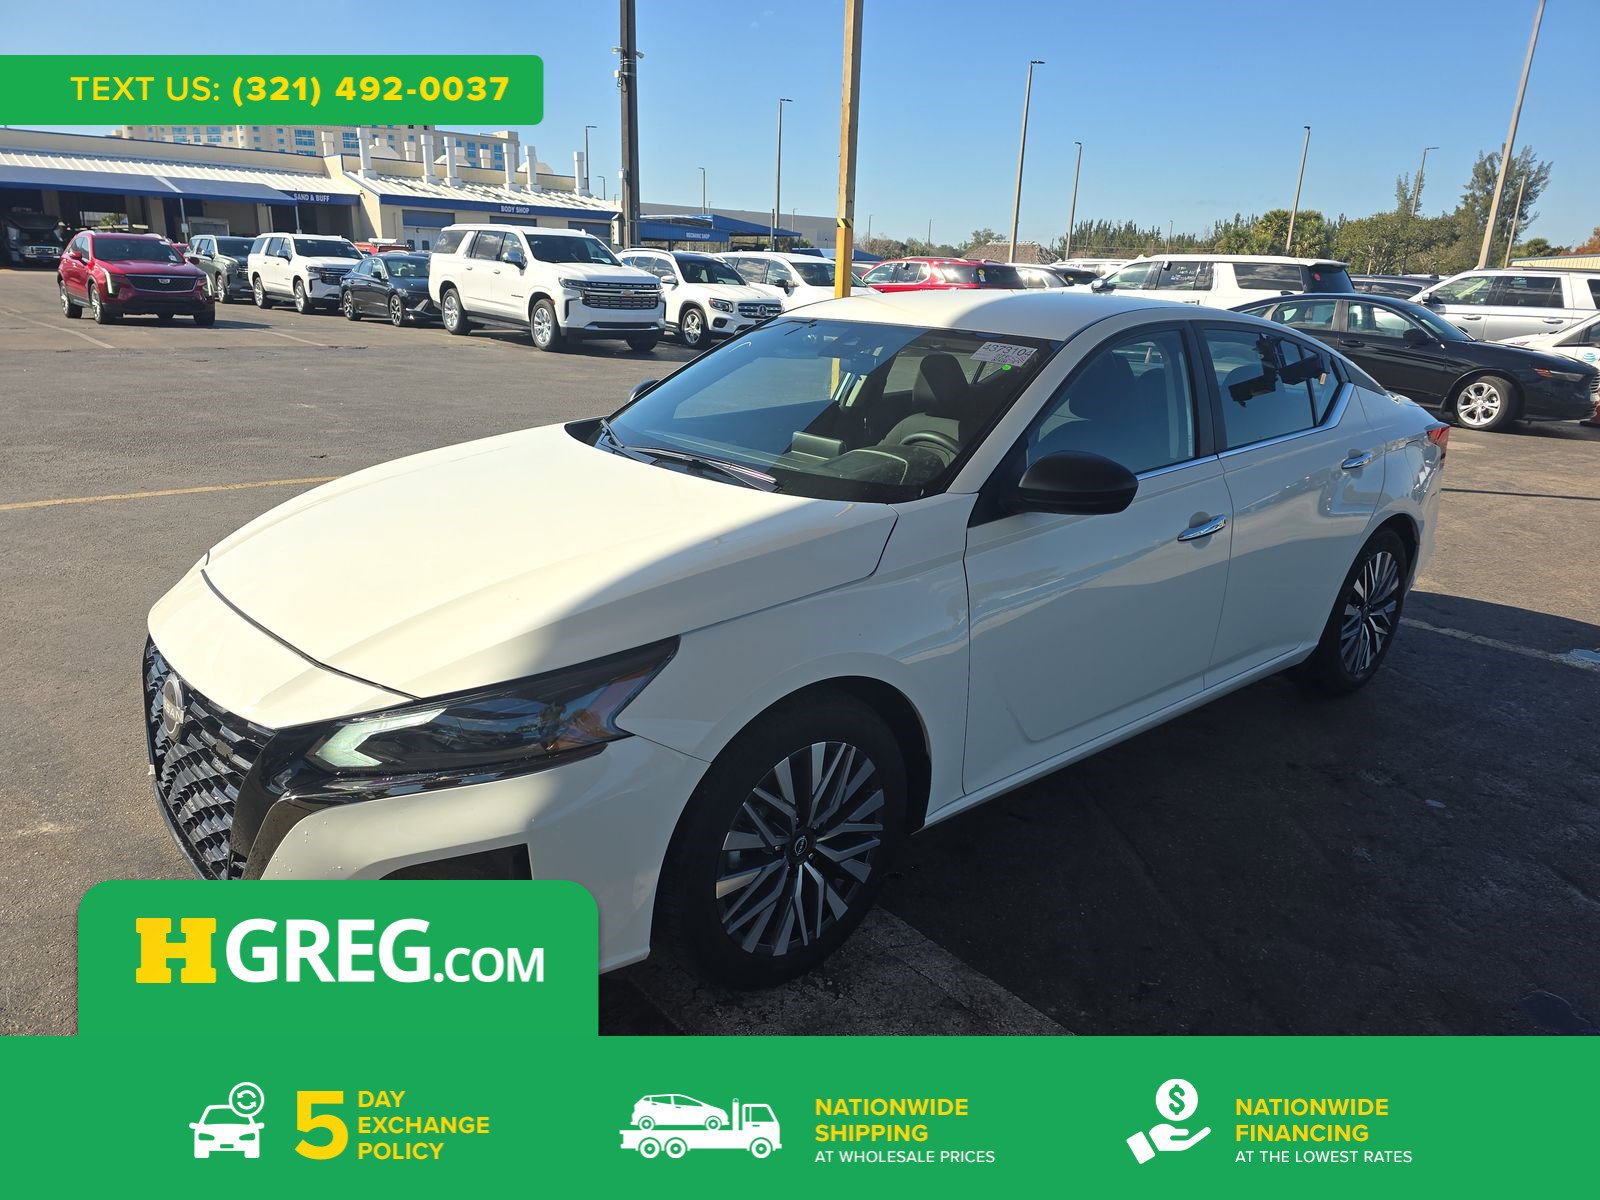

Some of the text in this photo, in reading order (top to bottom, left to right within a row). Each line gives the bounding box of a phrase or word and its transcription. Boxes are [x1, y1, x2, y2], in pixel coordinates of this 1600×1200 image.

[293, 193, 310, 201] SAND
[500, 205, 530, 214] BODY SHOP
